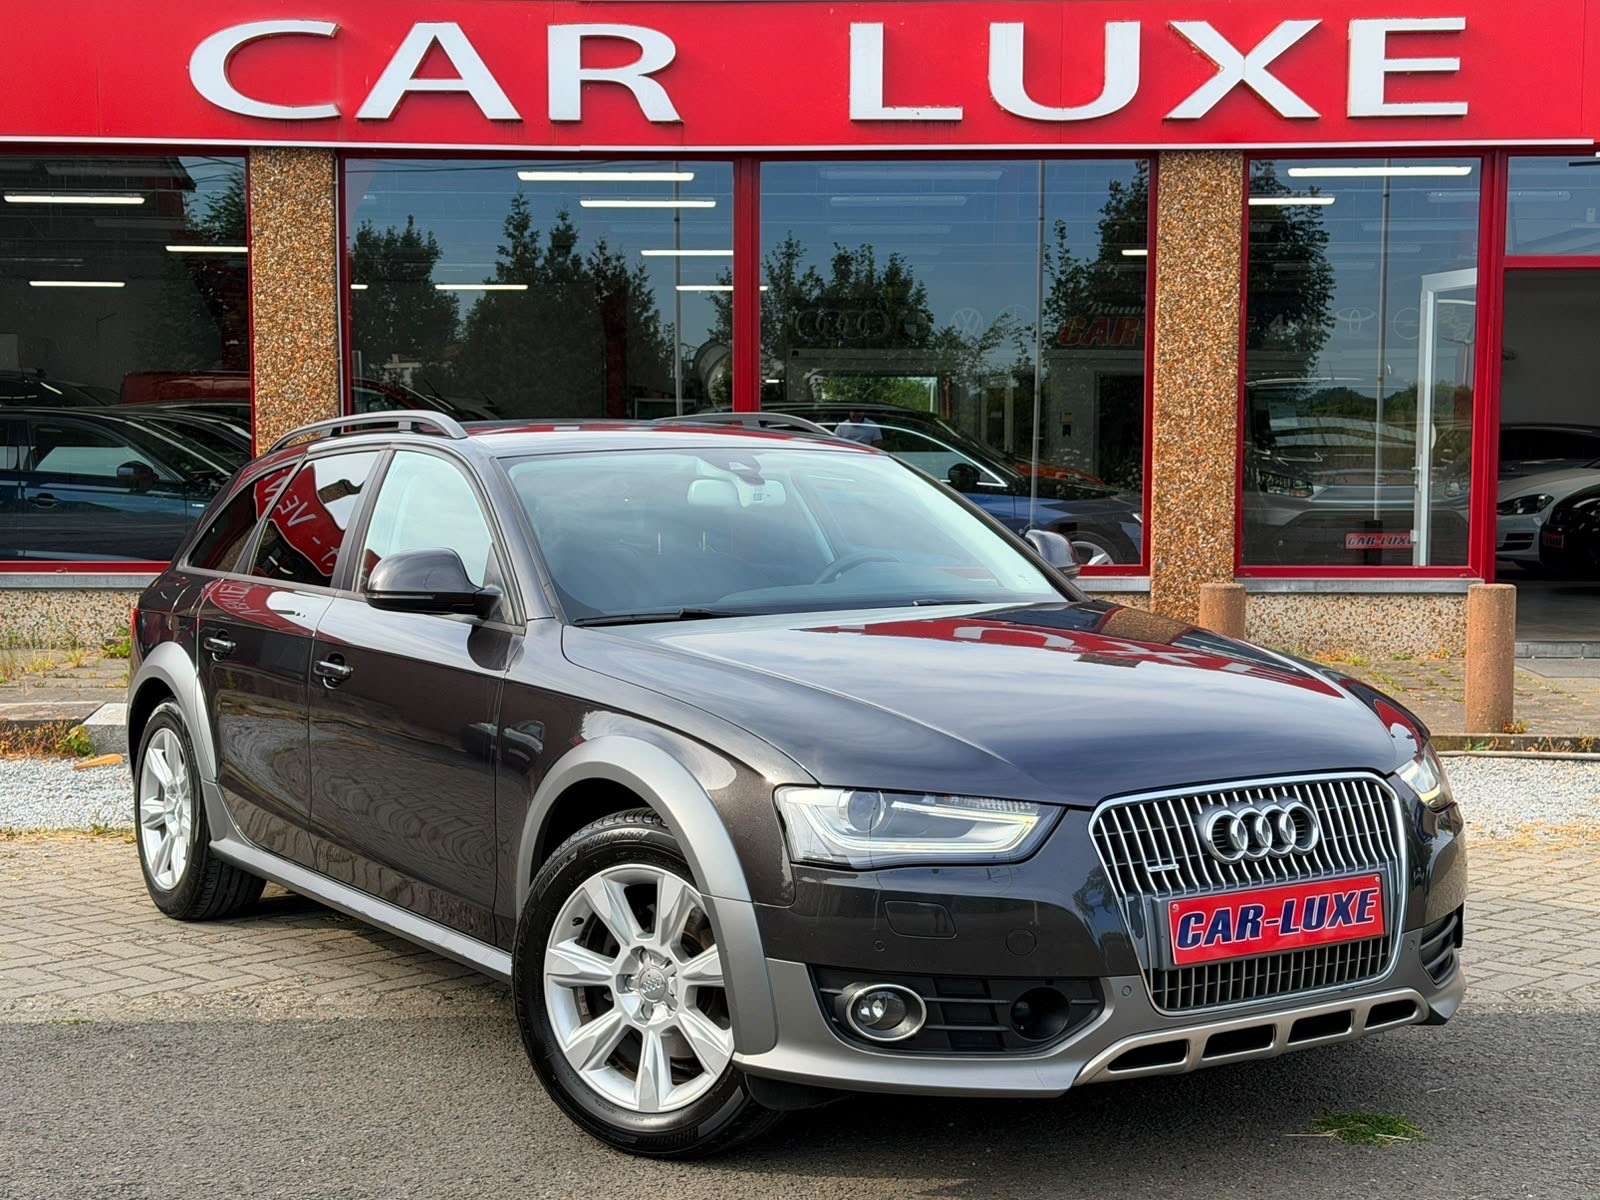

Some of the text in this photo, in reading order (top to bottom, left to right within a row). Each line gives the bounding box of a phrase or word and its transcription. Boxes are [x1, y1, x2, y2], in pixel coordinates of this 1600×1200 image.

[189, 17, 1469, 122] CAR LUXE
[1175, 887, 1379, 950] CAR-LUXE
